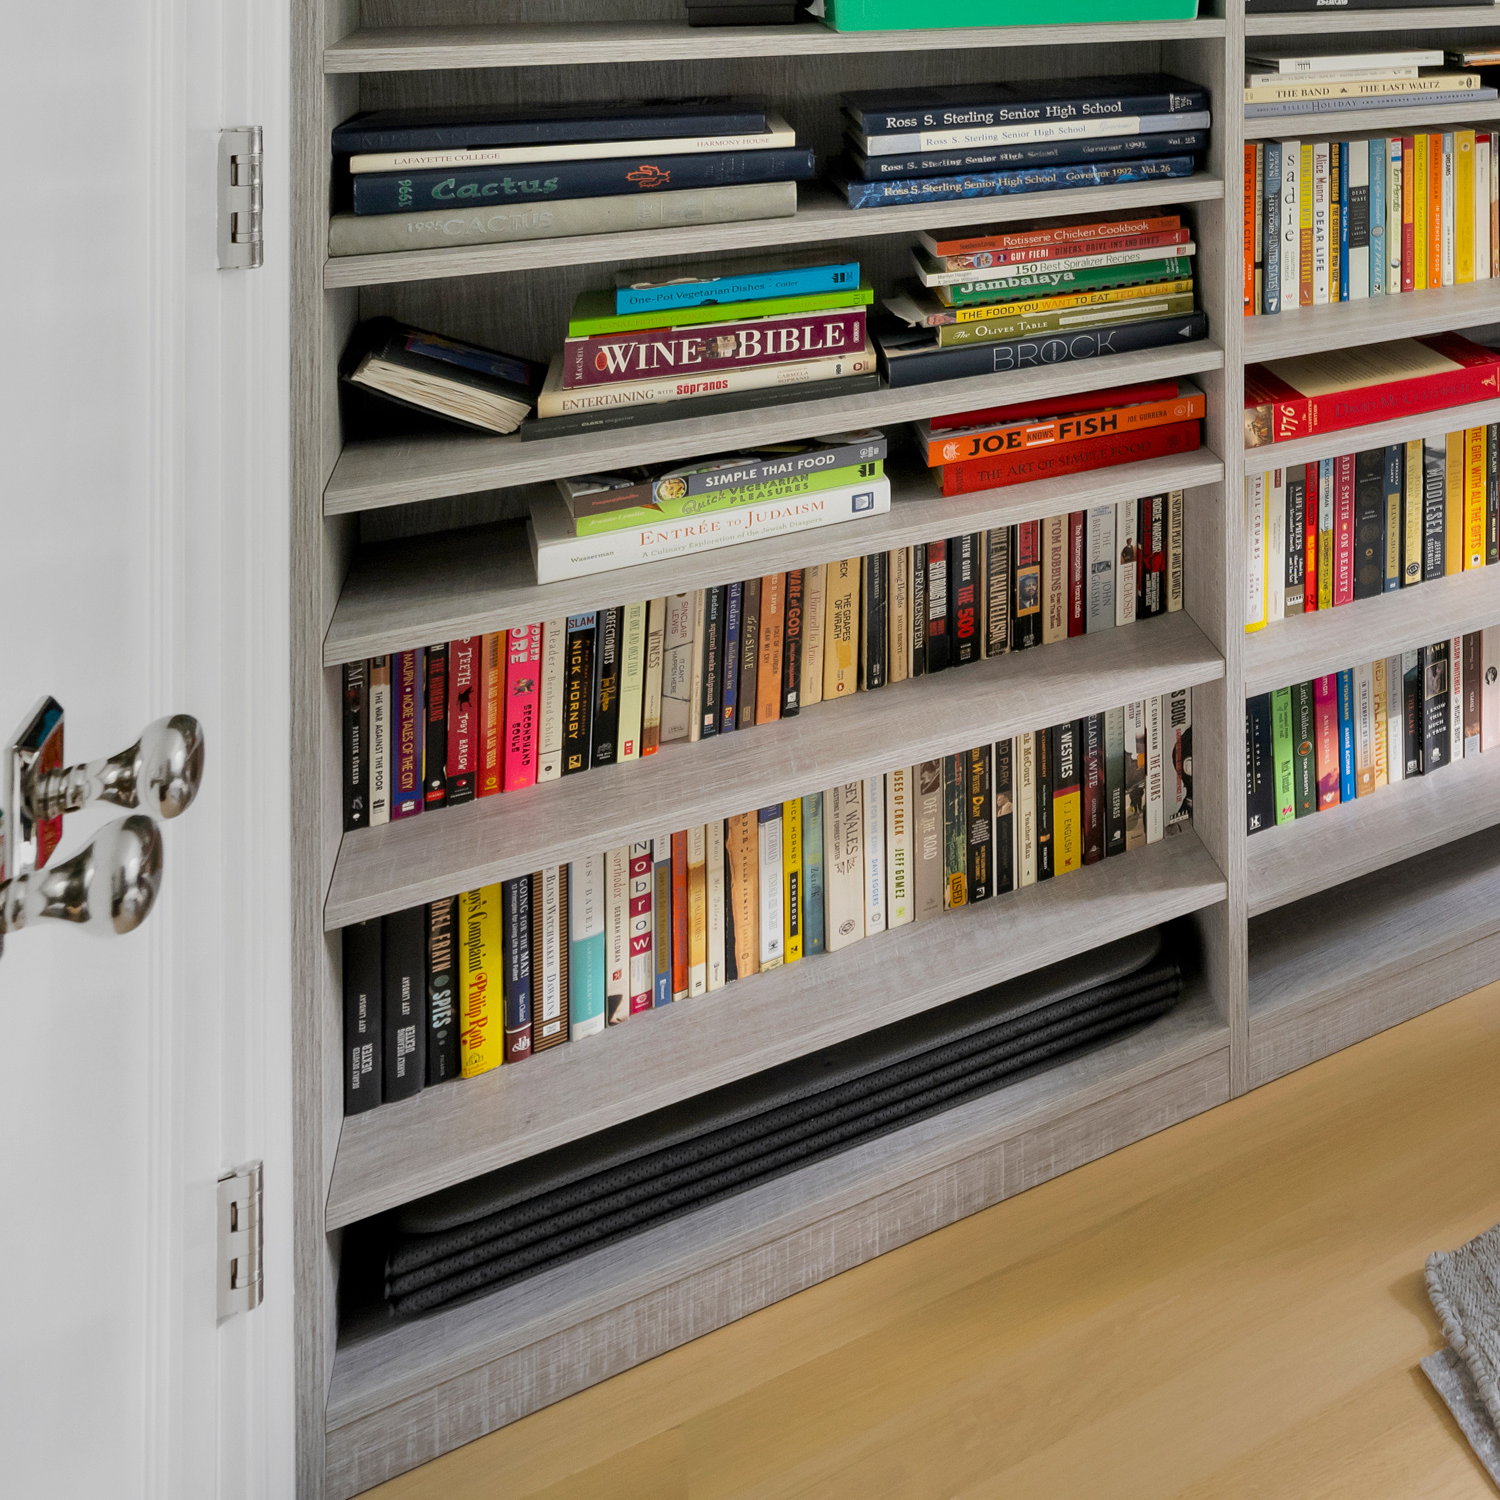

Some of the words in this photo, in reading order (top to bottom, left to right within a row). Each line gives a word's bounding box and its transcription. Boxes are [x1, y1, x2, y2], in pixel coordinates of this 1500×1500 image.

[1275, 88, 1299, 99] THE
[1301, 86, 1330, 98] BAND
[1358, 83, 1380, 93] THE
[1382, 82, 1403, 92] LAST
[1405, 80, 1440, 91] WALTZ
[886, 116, 918, 129] Ross
[924, 114, 938, 127] S.
[943, 110, 994, 127] Sterling
[999, 107, 1040, 121] Senior
[1045, 104, 1078, 119] High
[1082, 100, 1123, 114] School
[696, 138, 740, 148] HARMONY
[741, 136, 770, 146] HOUSE
[394, 155, 452, 165] LAFAYETTE
[454, 151, 500, 163] COLLEGE
[1316, 153, 1324, 174] Alice
[431, 175, 559, 200] Cactus
[884, 186, 909, 197] Ross
[910, 184, 922, 194] S.
[922, 180, 962, 196] Sterling
[963, 177, 997, 190] Senior
[998, 175, 1022, 189] High
[1024, 173, 1057, 186] School
[1316, 177, 1327, 203] Munro
[406, 219, 444, 234] 1995
[442, 210, 553, 238] CACTUS
[1003, 233, 1052, 247] Rotisserie
[1053, 226, 1096, 241] Chicken
[1098, 220, 1149, 236] Cookbook
[1316, 211, 1325, 242] DEAR
[1010, 251, 1026, 262] GUY
[1027, 249, 1049, 260] FIERI
[1014, 263, 1038, 276] 150
[1040, 261, 1061, 273] Best
[1063, 257, 1105, 272] Spiralizer
[1106, 252, 1141, 266] Recipes
[1316, 249, 1324, 272] LIFE
[629, 291, 671, 306] One-Pot
[674, 286, 730, 301] Vegetarian
[731, 282, 765, 294] Dishes
[960, 271, 1075, 295] Jambalaya
[961, 309, 983, 321] THE
[985, 305, 1016, 318] FOOD
[1017, 302, 1039, 314] YOU
[1041, 298, 1072, 310] WANT
[1074, 295, 1088, 306] TO
[1090, 293, 1110, 304] EAT
[597, 337, 702, 374] WINE
[734, 322, 845, 360] BIBLE
[952, 330, 971, 341] The
[993, 331, 1117, 373] BROCK
[562, 389, 655, 411] ENTERTAINING
[1279, 405, 1298, 437] 1776
[968, 431, 1022, 457] JOE
[1027, 429, 1054, 442] KNOWS
[1059, 414, 1118, 440] FISH
[1472, 427, 1482, 443] THE
[1472, 445, 1481, 464] GIRL
[706, 468, 757, 488] SIMPLE
[762, 461, 793, 478] THAI
[797, 454, 836, 473] FOOD
[1472, 466, 1481, 489] WITH
[729, 474, 810, 496] VEGETARIAN
[729, 482, 810, 504] PLEASURES
[1472, 490, 1481, 505] ALL
[682, 488, 726, 514] Quick
[1341, 485, 1350, 520] SMITH
[1426, 469, 1444, 536] MIDDLESEX
[1472, 506, 1481, 522] THE
[1341, 533, 1349, 548] ON
[1471, 523, 1481, 549] GIFTS
[570, 549, 615, 564] Wasserman
[1340, 552, 1349, 593] BEAUTY
[834, 599, 842, 610] OF
[842, 592, 851, 609] THE
[958, 583, 975, 605] THE
[568, 616, 594, 629] SLAM
[671, 609, 679, 634] LEWIS
[680, 601, 688, 638] SINCLAIR
[913, 570, 924, 650] FRANKENSTEIN
[957, 607, 974, 638] 500
[832, 611, 842, 640] WRATH
[841, 610, 851, 642] GRAPES
[572, 640, 582, 674] NICK
[568, 681, 580, 739] HORNBY
[512, 723, 521, 753] SOULS
[522, 704, 532, 766] SECONDHAND
[1061, 732, 1073, 779] WESTIES
[950, 875, 964, 905] USED
[464, 972, 488, 1018] Philip
[432, 989, 452, 1029] SPIES
[460, 1016, 488, 1050] Roth
